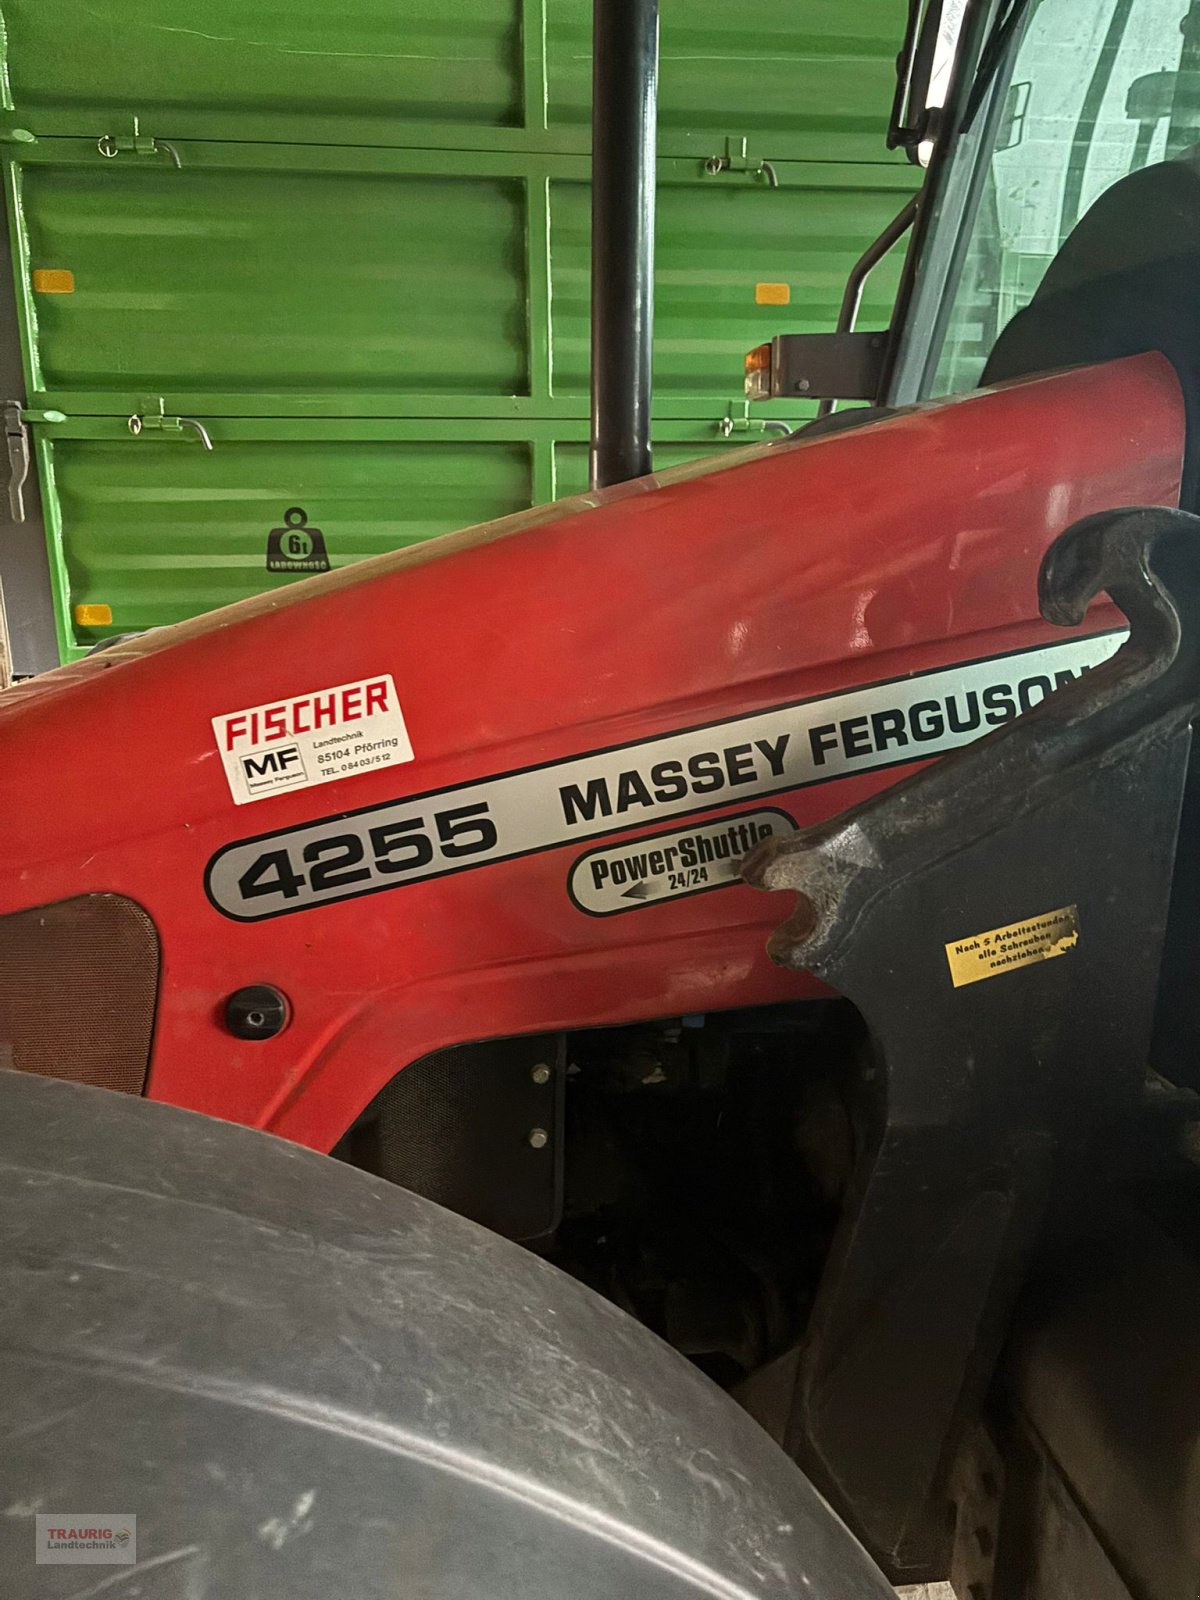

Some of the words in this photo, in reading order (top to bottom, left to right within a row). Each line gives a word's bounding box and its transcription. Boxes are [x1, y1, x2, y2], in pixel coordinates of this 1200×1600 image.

[226, 680, 390, 751] FISCHER
[313, 730, 364, 749] Landtechnik
[317, 747, 351, 764] 85104
[354, 737, 399, 755] Pförring
[243, 747, 299, 779] MF
[237, 802, 498, 900] 4255
[558, 733, 791, 826] MASSEY
[667, 866, 709, 890] 24/24
[955, 938, 980, 955] Nach
[983, 937, 991, 947] 5
[978, 948, 997, 960] alle
[1000, 932, 1052, 953] Schrauben
